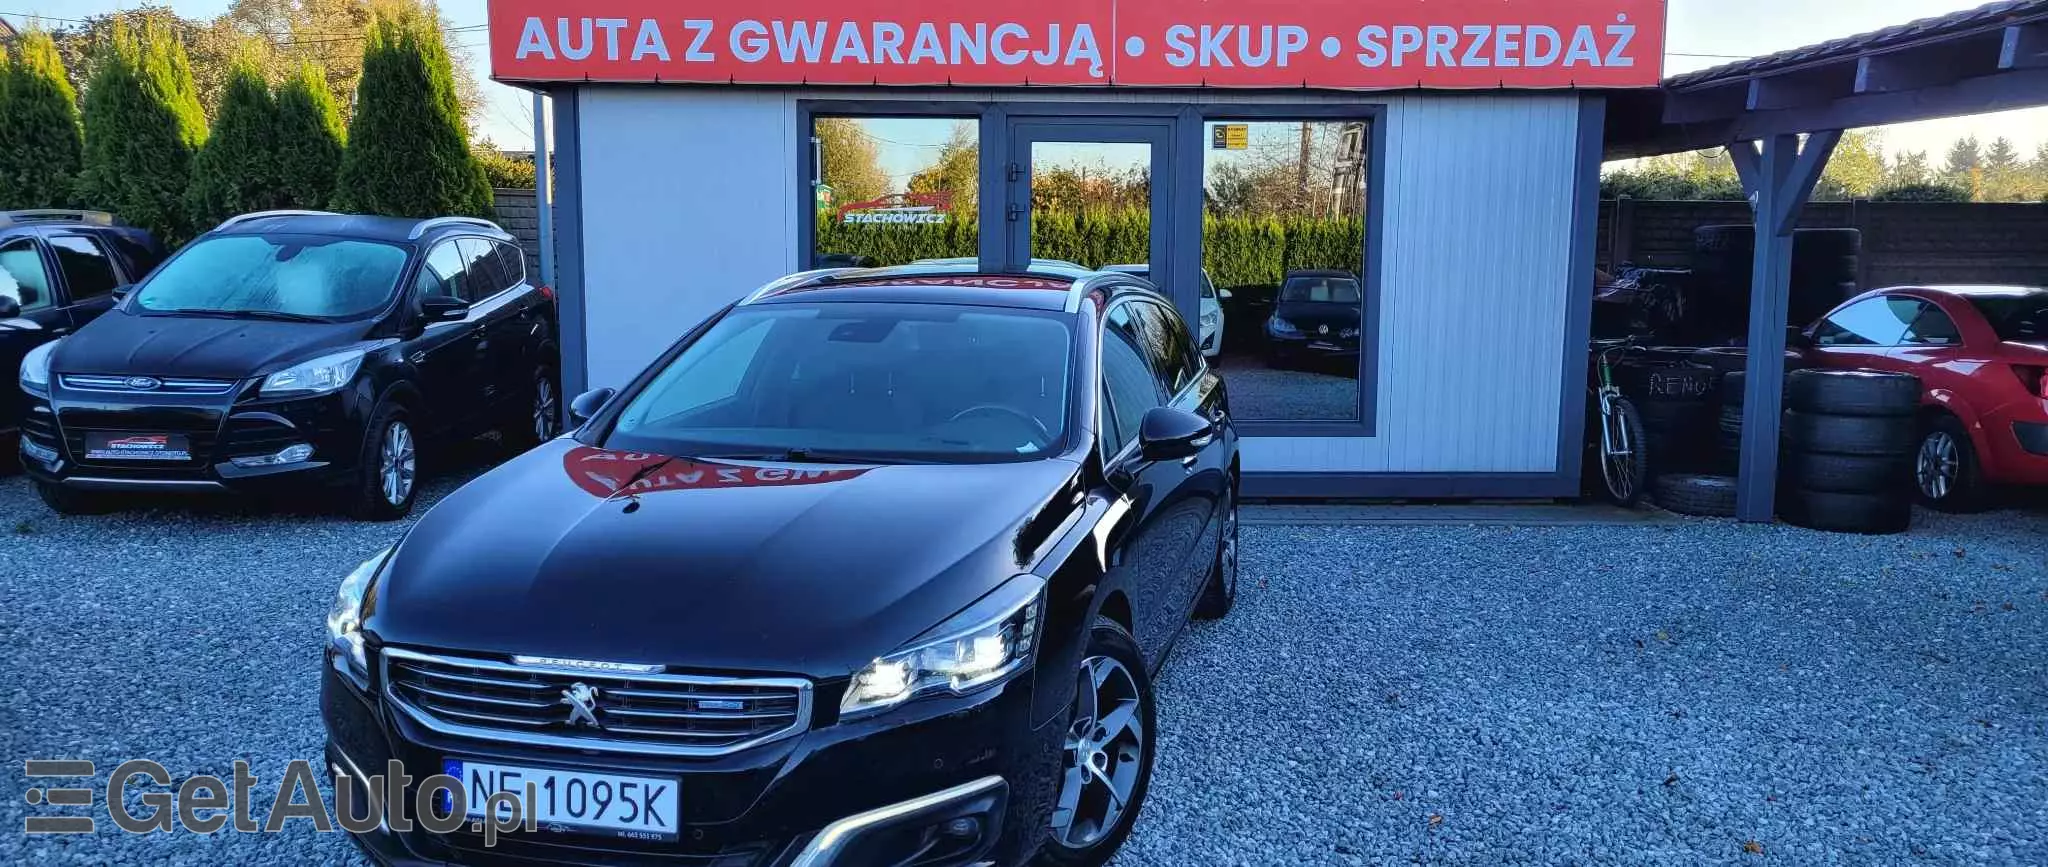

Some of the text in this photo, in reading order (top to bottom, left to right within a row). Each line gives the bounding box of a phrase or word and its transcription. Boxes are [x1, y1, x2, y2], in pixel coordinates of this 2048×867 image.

[516, 13, 1636, 78] AUTA Z GWARANCJĄ SKUP SPRZEDAŻ
[843, 213, 945, 224] STACHOWICZ
[539, 658, 623, 671] PEUGEOT
[543, 775, 667, 827] 1095K
